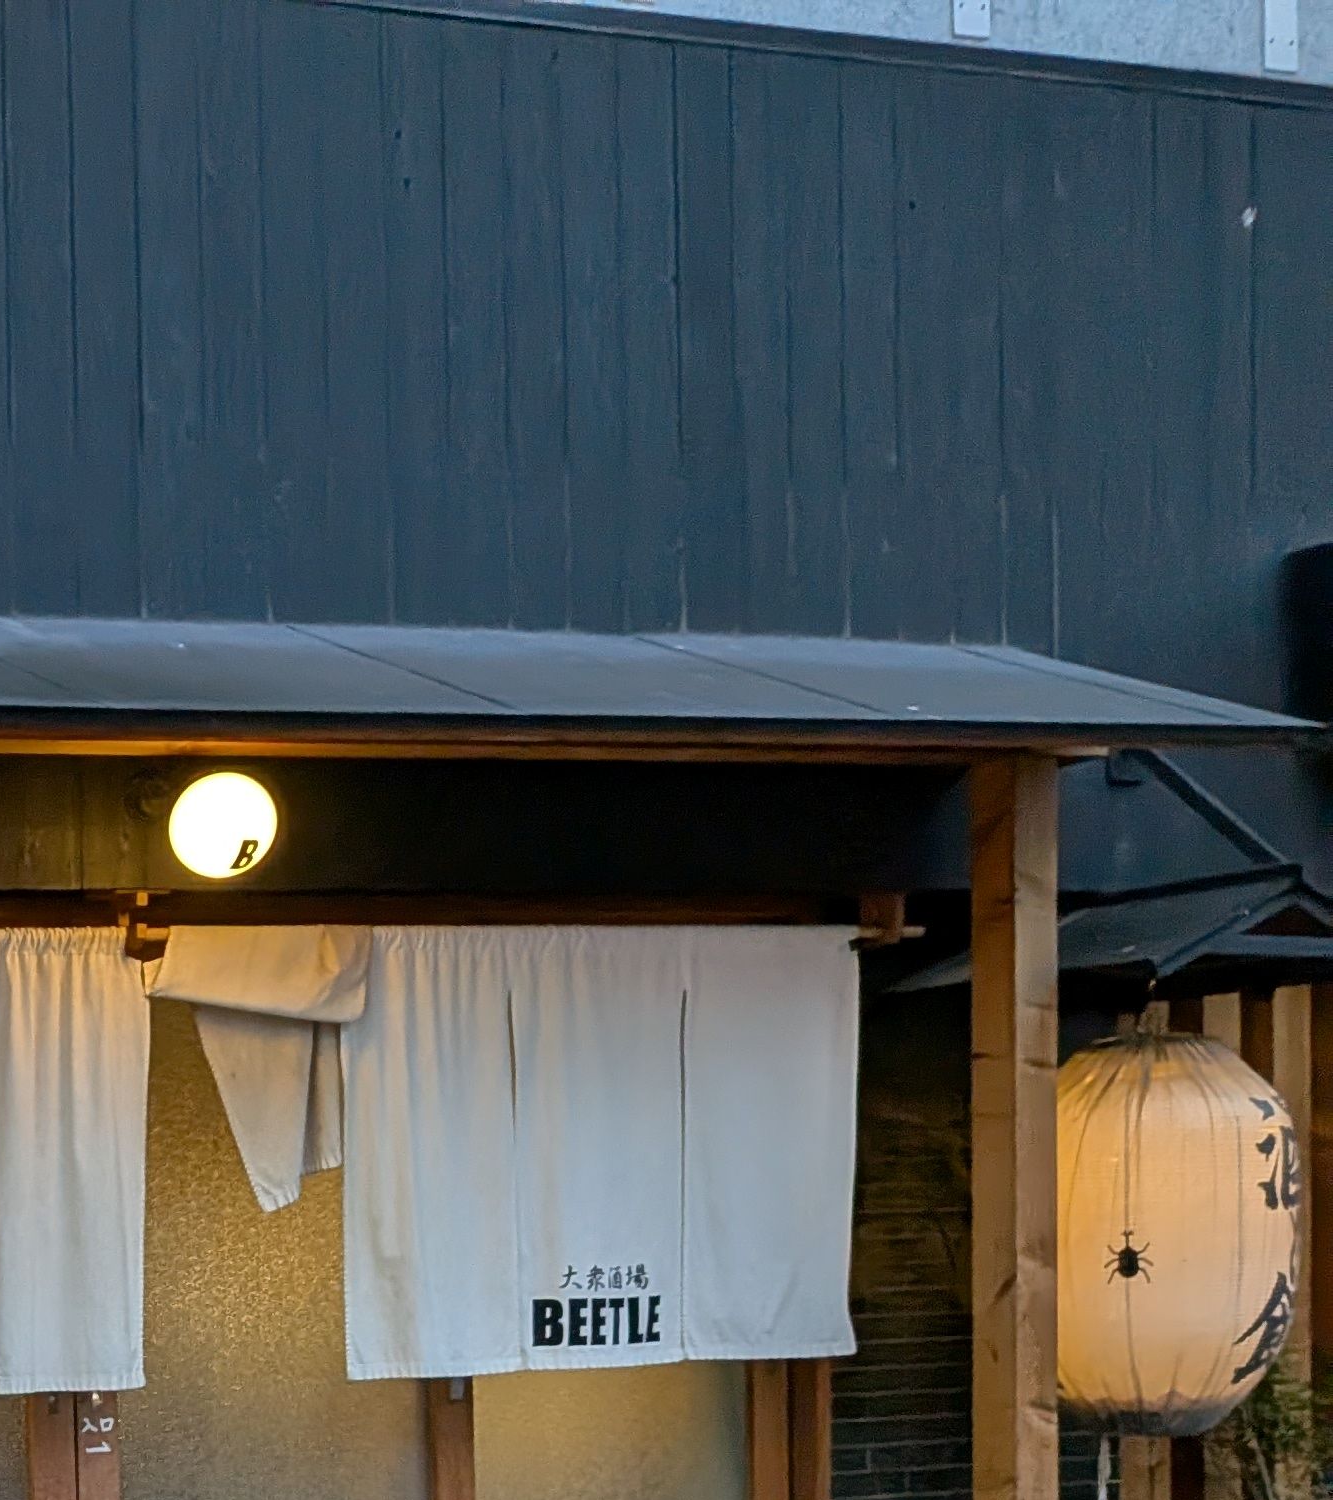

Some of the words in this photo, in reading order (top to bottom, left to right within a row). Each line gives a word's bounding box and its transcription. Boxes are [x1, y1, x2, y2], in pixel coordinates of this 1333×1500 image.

[229, 839, 259, 869] B
[559, 1263, 649, 1292] 大衆酒場
[532, 1295, 661, 1347] BEETLE
